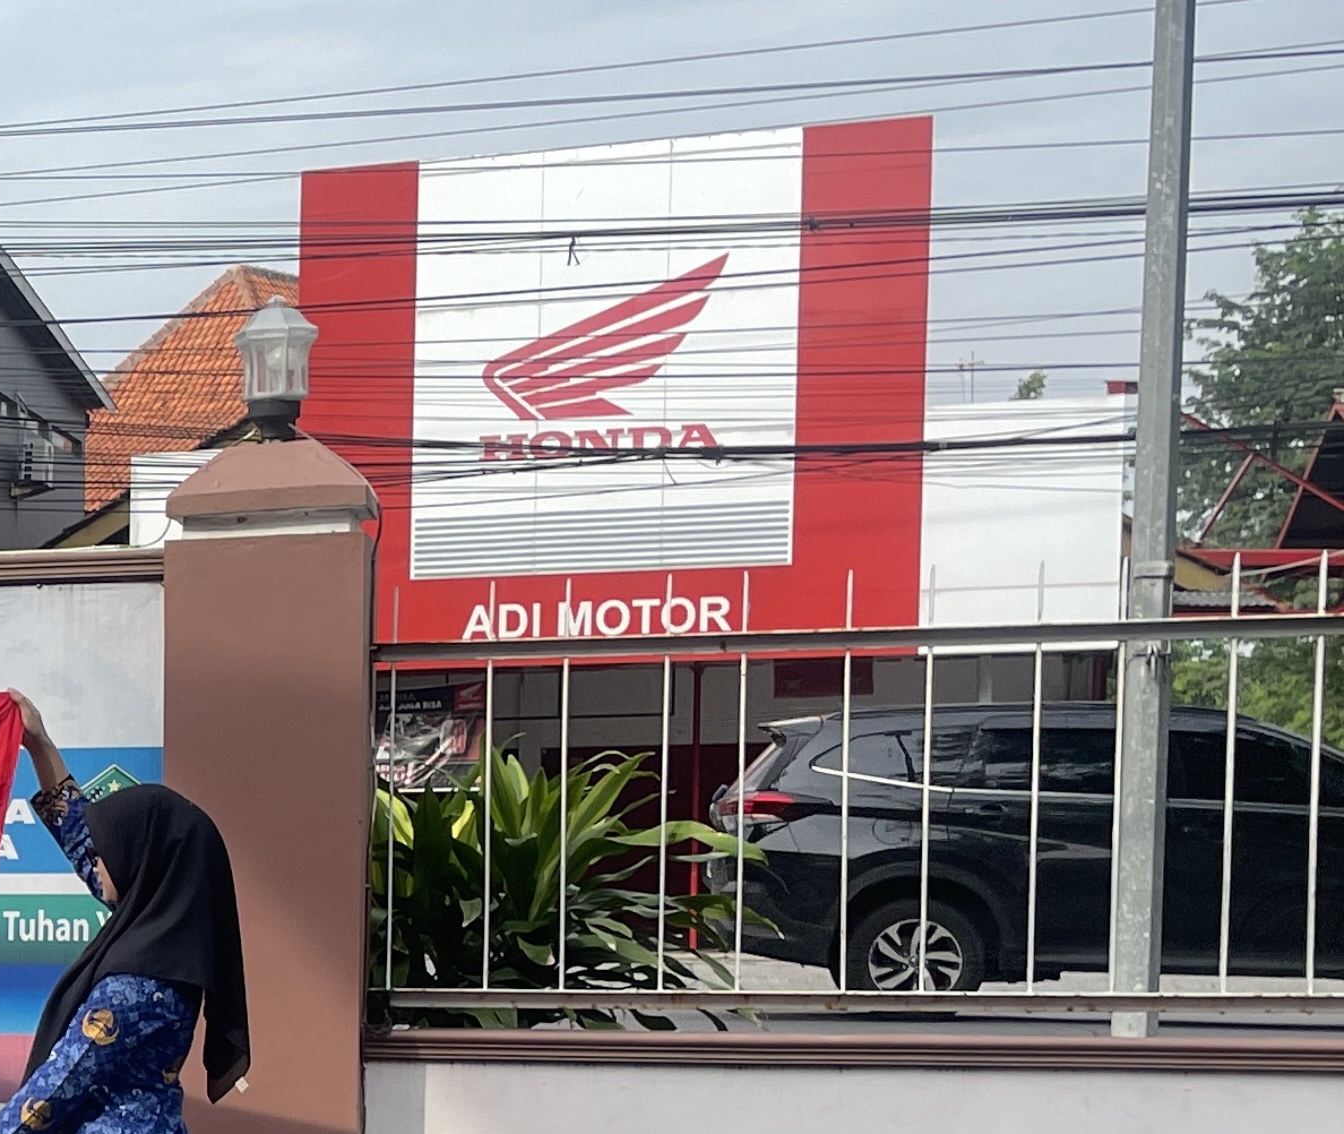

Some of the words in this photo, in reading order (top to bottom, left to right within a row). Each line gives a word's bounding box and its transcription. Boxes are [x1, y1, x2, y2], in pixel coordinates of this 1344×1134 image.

[479, 423, 721, 461] HONDA
[462, 602, 541, 641] ADI
[557, 596, 732, 637] MOTOR
[3, 909, 90, 942] Tuhan
